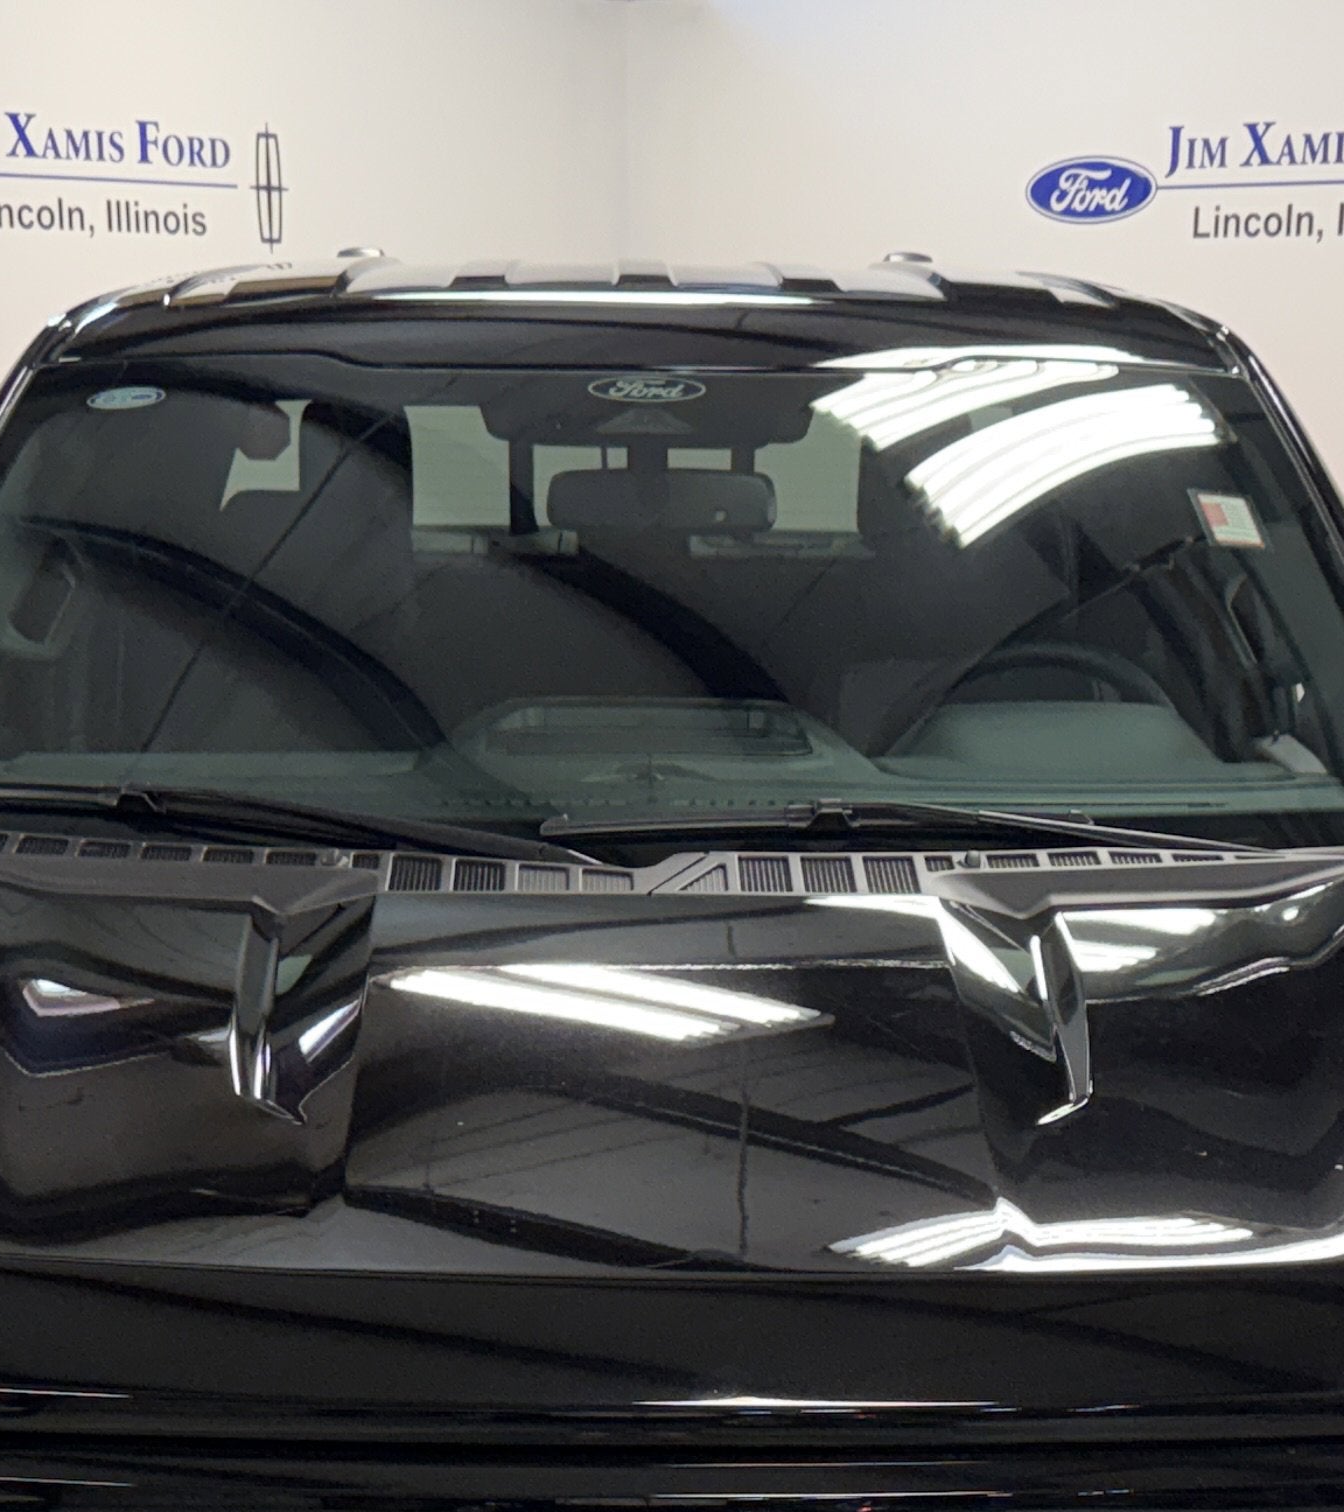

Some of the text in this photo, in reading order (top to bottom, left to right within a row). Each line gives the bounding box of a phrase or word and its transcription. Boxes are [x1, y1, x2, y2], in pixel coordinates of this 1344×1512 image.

[4, 111, 125, 164] XAMIS
[136, 119, 231, 169] FORD
[1164, 125, 1229, 179] JIM
[1050, 168, 1131, 213] Ford
[105, 199, 208, 237] Illinois
[1192, 202, 1324, 244] Lincoln,
[608, 379, 685, 399] Ford
